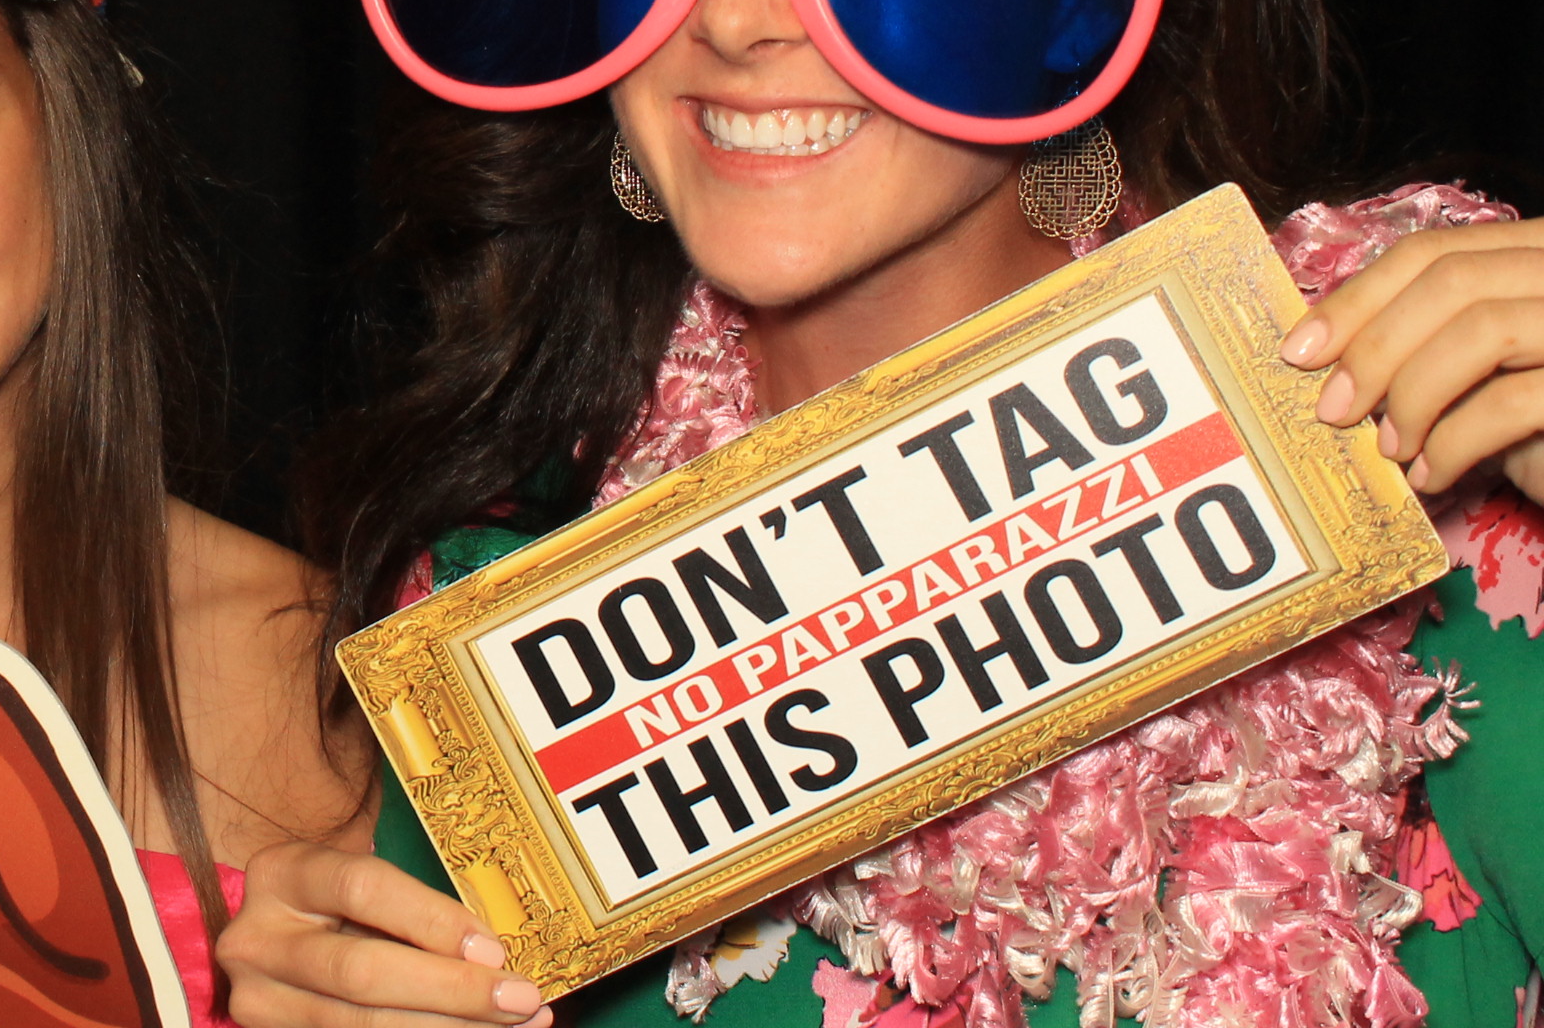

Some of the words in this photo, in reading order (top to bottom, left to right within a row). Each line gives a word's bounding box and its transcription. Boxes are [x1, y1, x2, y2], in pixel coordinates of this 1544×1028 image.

[510, 465, 885, 729] DON'T
[898, 337, 1168, 522] TAG
[572, 688, 858, 879] THIS
[861, 483, 1276, 748] PHOTO
[622, 683, 724, 748] NO
[731, 453, 1165, 691] PAPPARAZZI
